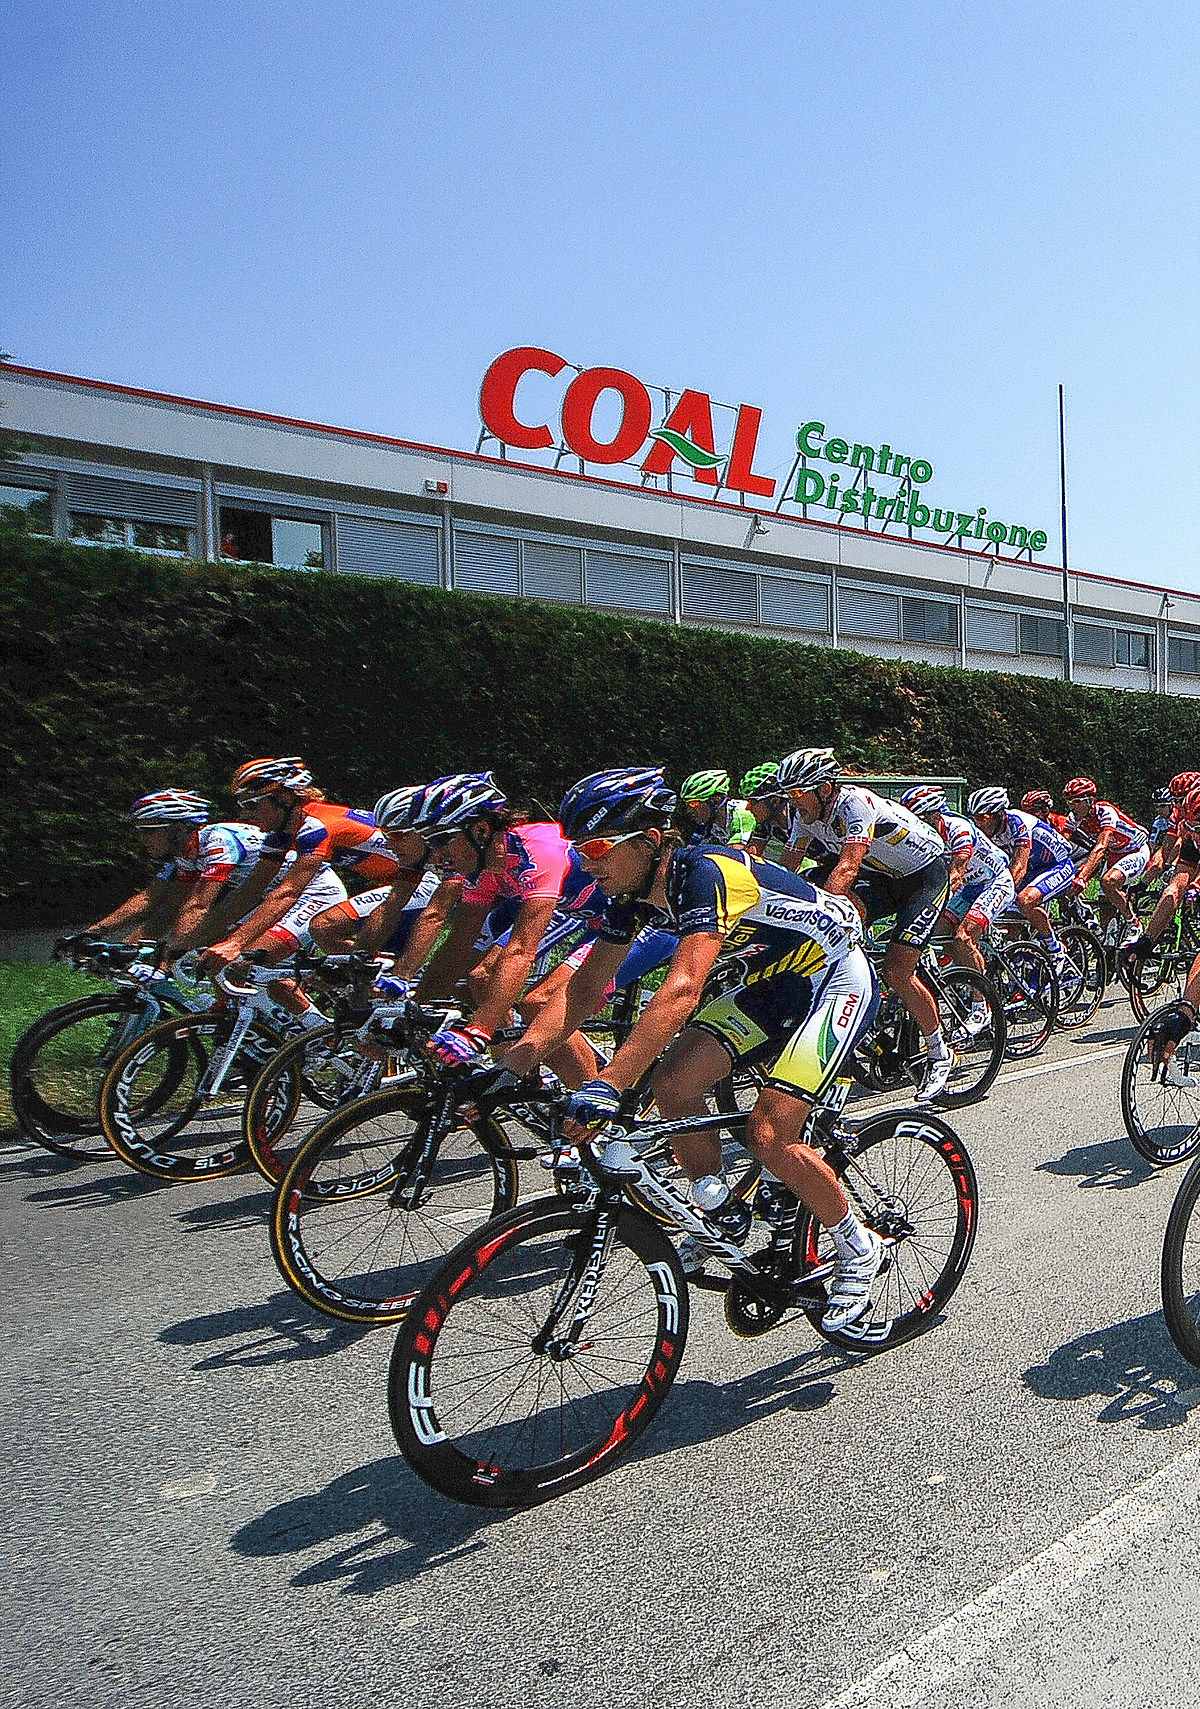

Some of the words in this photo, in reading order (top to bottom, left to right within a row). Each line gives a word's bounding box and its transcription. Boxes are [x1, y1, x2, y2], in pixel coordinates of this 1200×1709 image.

[480, 346, 776, 497] COAL
[796, 421, 933, 483] Centro
[794, 466, 1048, 552] Distribuzione
[353, 891, 390, 906] Rabo
[837, 993, 860, 1029] DCM
[574, 1211, 610, 1322] VREDESTEIN
